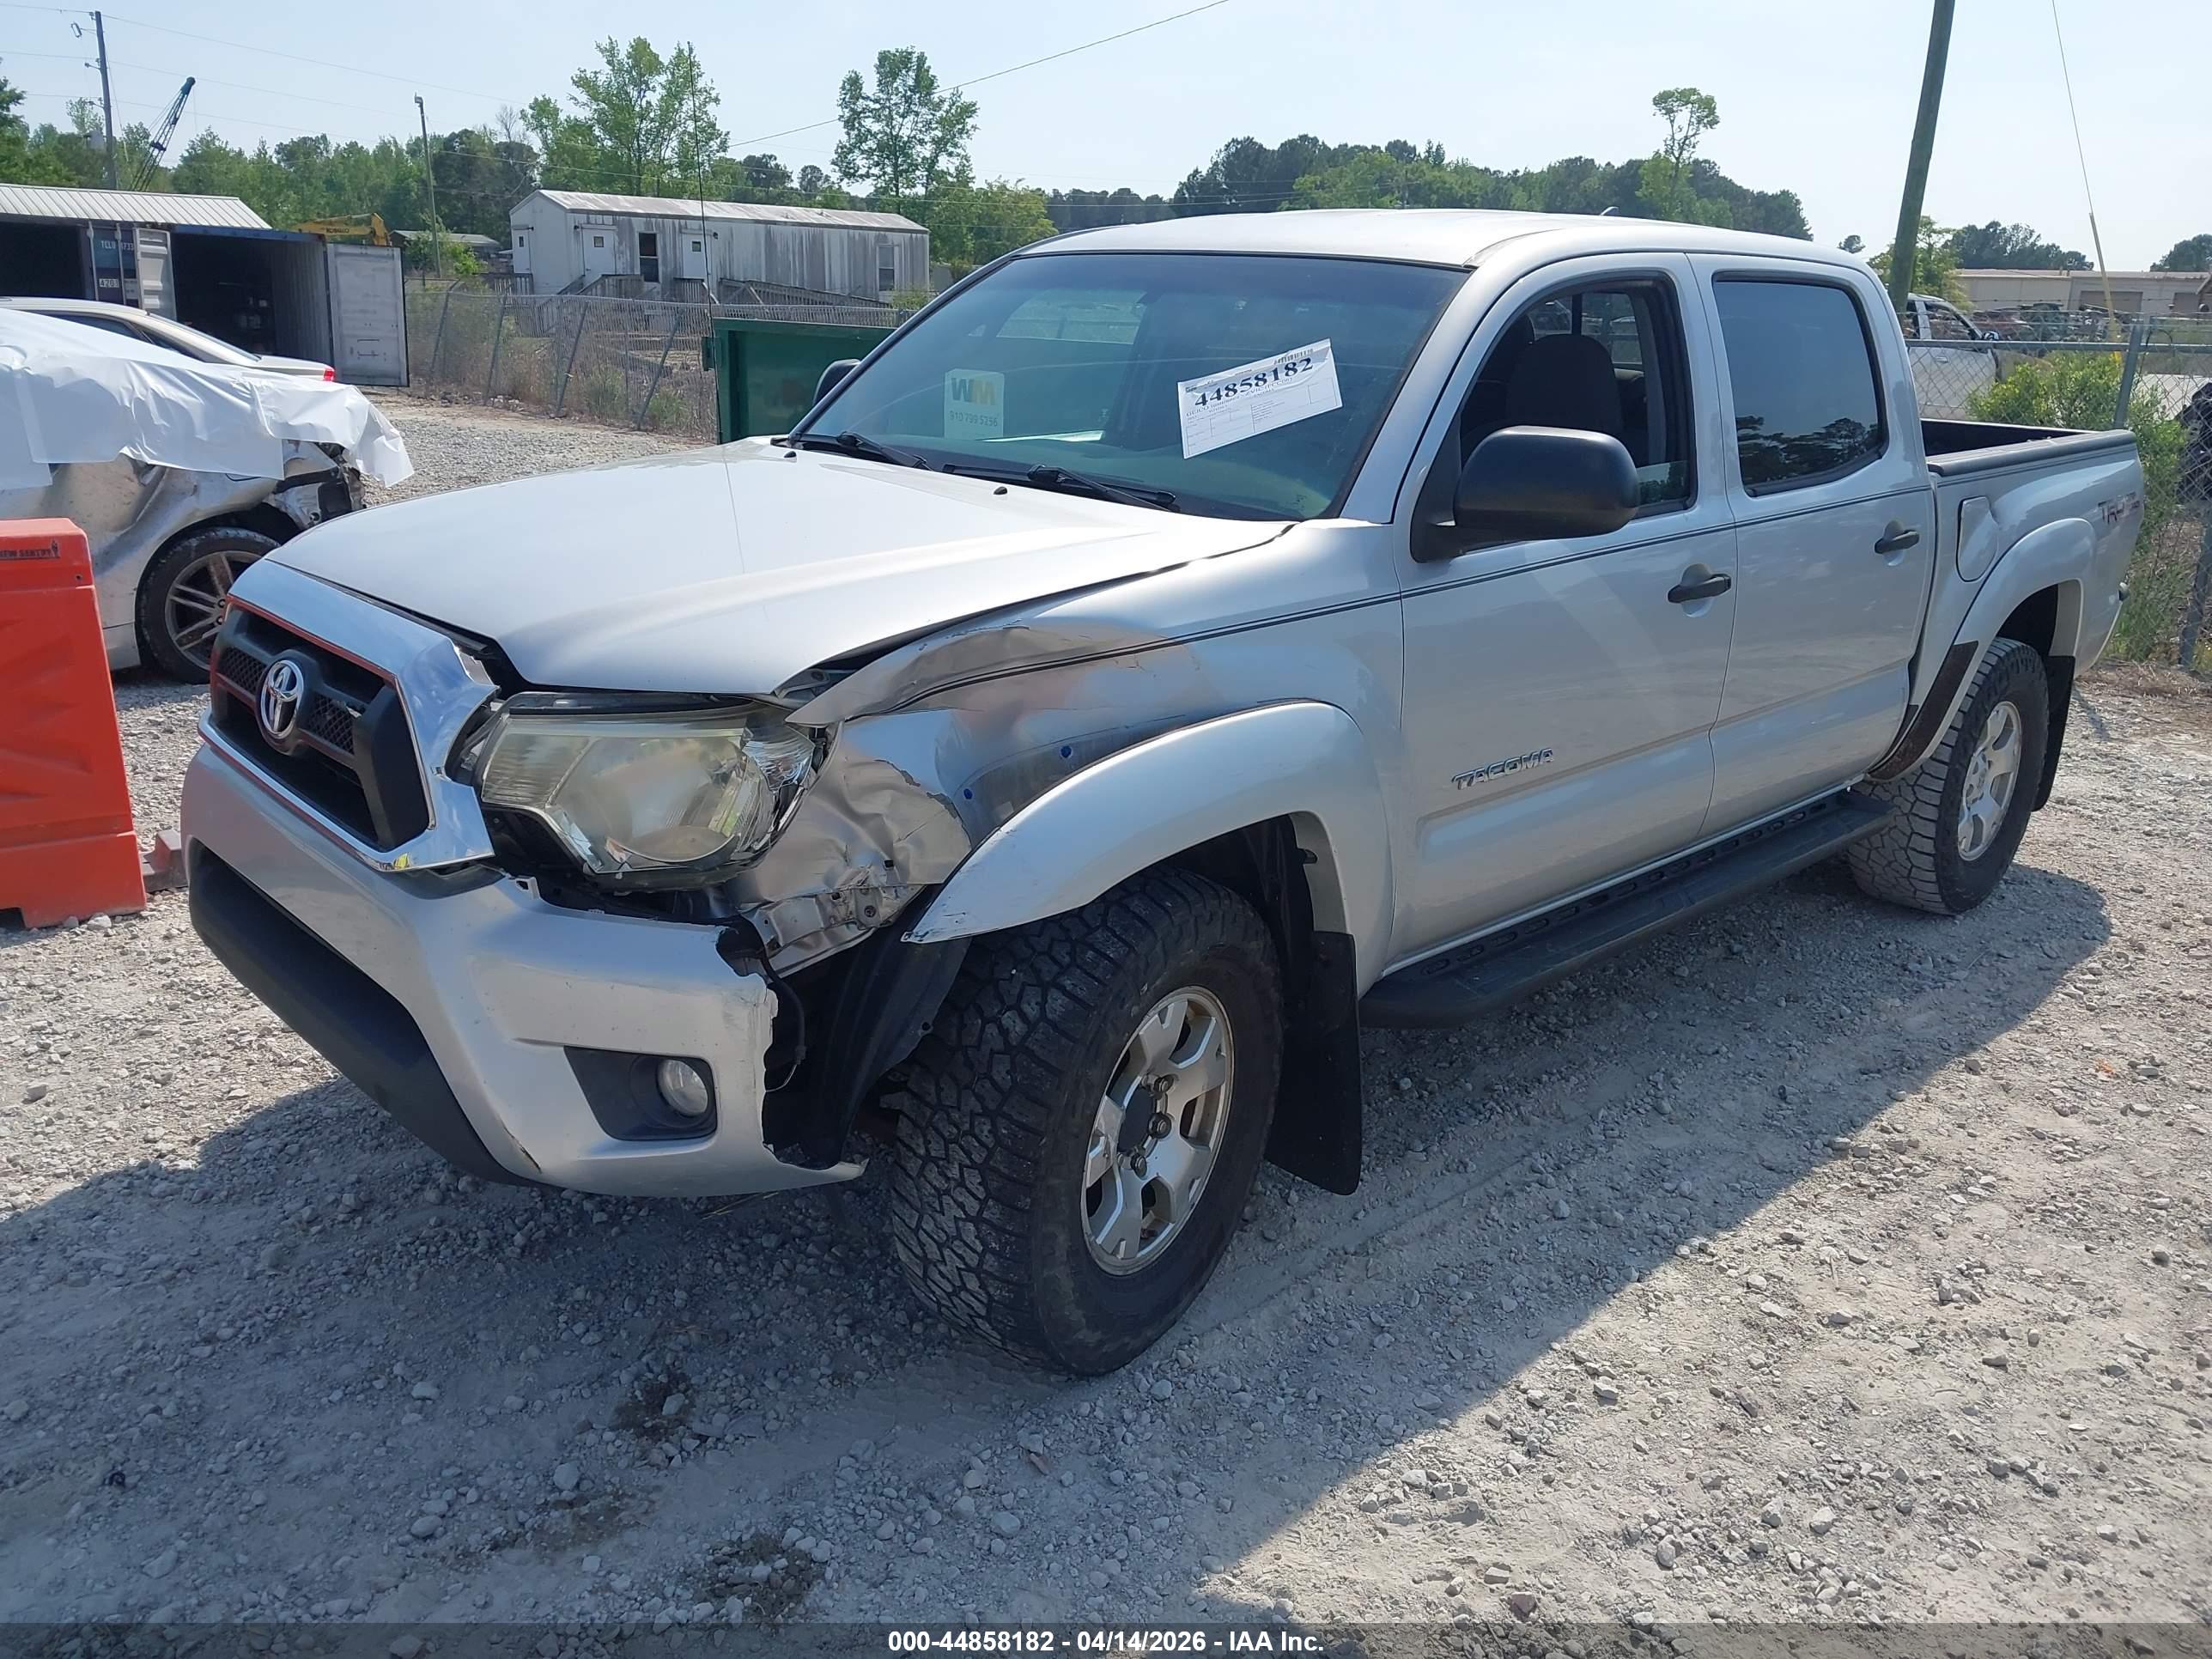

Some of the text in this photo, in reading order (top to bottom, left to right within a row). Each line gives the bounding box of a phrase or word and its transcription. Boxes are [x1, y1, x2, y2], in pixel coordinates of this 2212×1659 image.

[951, 377, 997, 406] WM
[1194, 357, 1314, 407] 44858182
[1451, 748, 1555, 790] TACOMA
